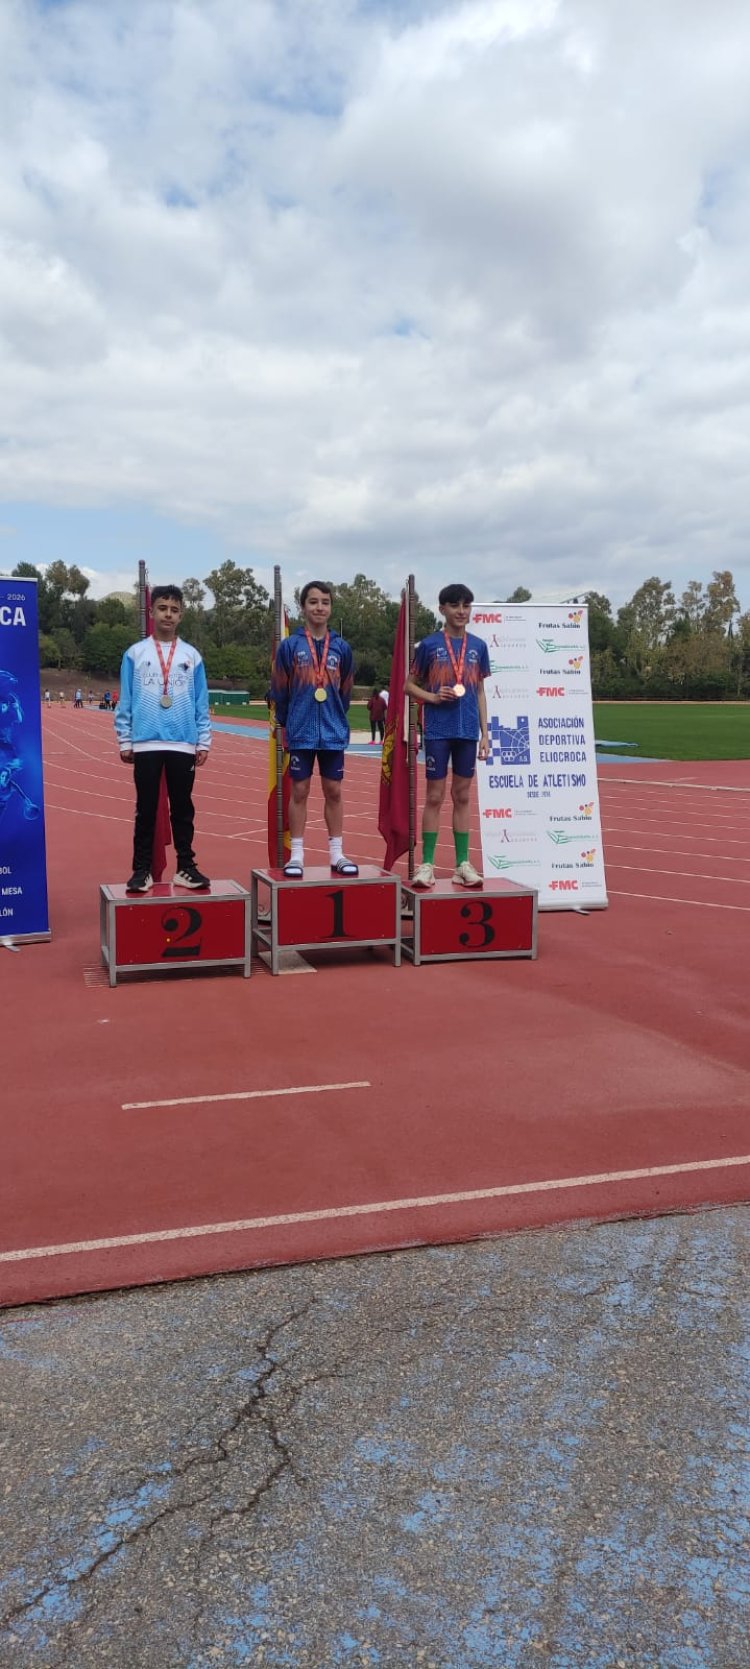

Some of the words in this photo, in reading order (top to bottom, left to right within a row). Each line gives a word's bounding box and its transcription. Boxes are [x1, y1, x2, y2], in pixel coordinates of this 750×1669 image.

[7, 593, 26, 602] 2026
[473, 613, 503, 624] FMC
[536, 687, 565, 697] FMC
[538, 715, 584, 728] ASOCIACIÓN
[538, 734, 586, 746] DEPORTIVA
[540, 752, 587, 763] ELIOCROCA
[489, 775, 525, 789] ESCUELA
[528, 774, 538, 788] DE
[543, 774, 586, 788] ATLETISMO
[482, 808, 512, 819] FMC
[549, 815, 571, 823] Frutas
[549, 879, 579, 891] FMC
[1, 886, 23, 896] MESA
[326, 889, 349, 938] 1
[458, 901, 496, 949] 3
[161, 905, 203, 959] 2
